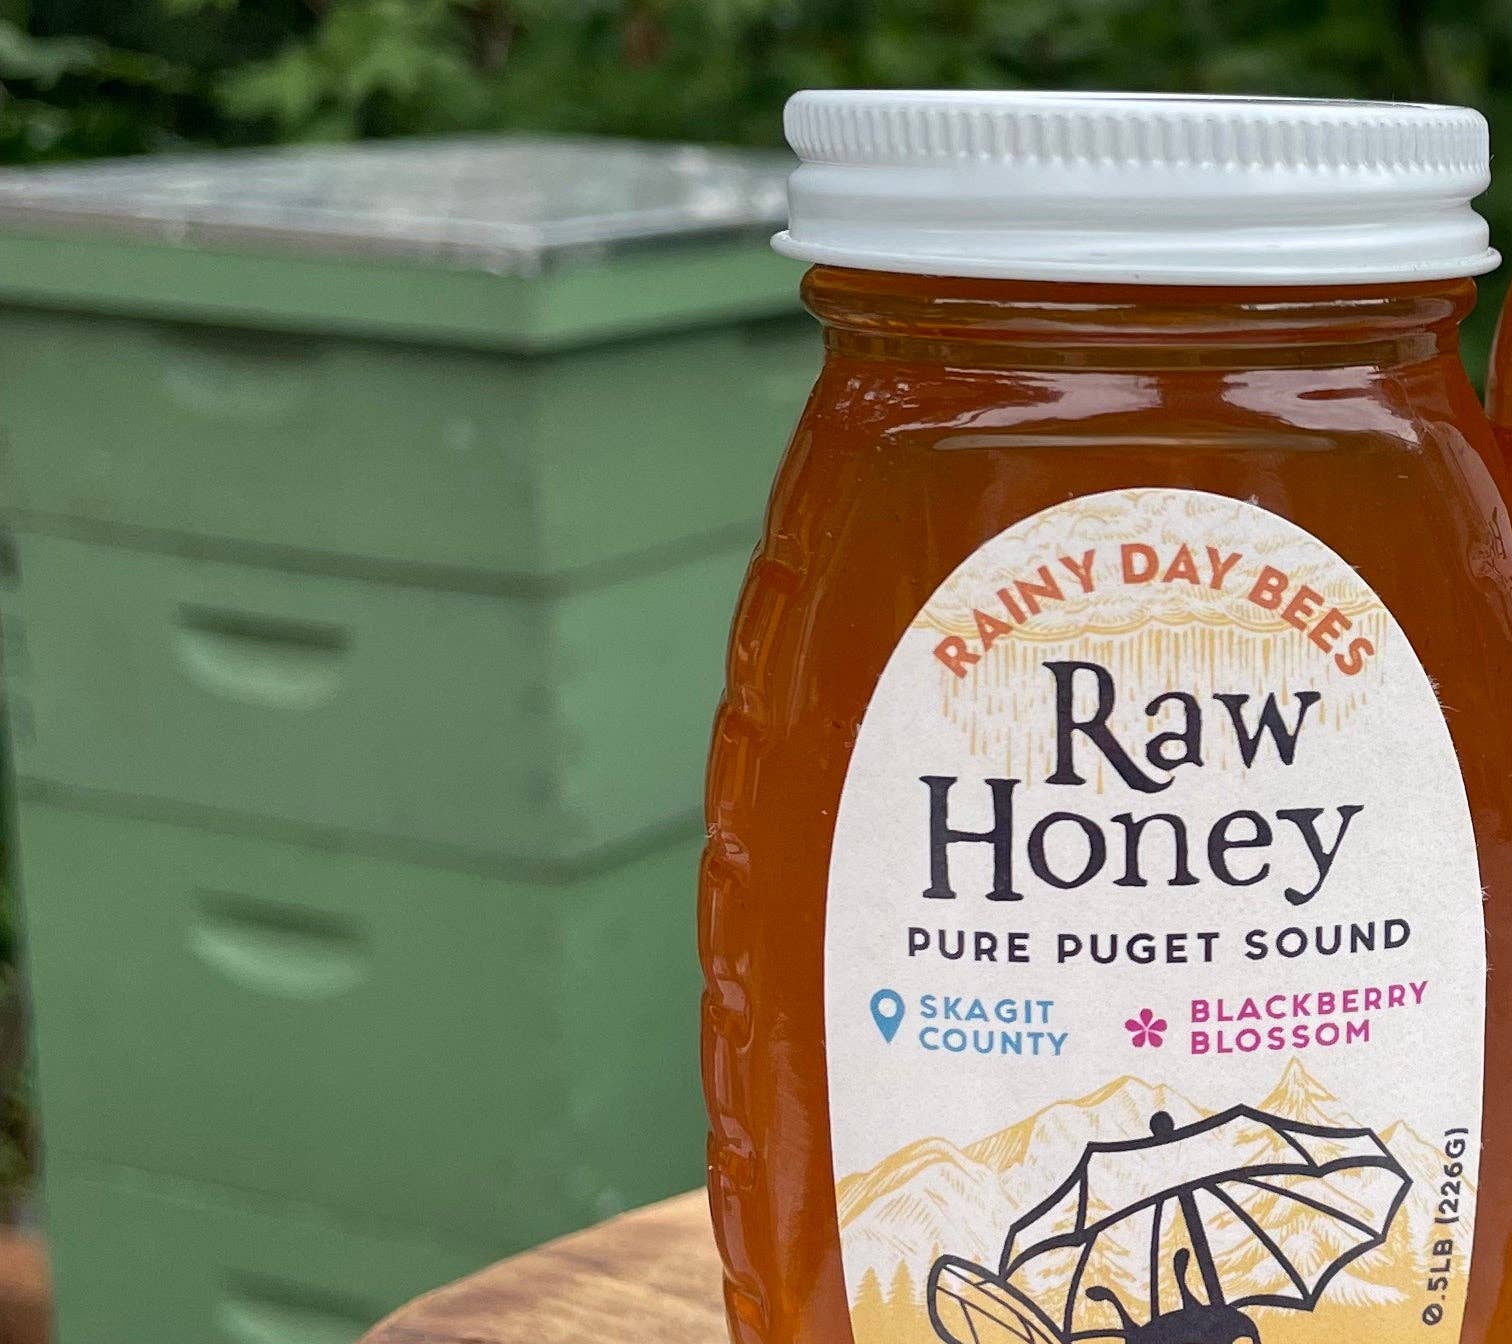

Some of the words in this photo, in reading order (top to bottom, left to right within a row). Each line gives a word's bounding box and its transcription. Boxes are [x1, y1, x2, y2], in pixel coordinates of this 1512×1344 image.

[932, 548, 1098, 679] RAINY
[1120, 542, 1242, 590] DAY
[1248, 563, 1375, 678] BEES
[1042, 660, 1322, 794] Raw
[919, 775, 1365, 907] Honey
[908, 927, 1031, 963] PURE
[1057, 932, 1220, 965] PUGET
[1244, 918, 1412, 962] SOUND
[919, 994, 1055, 1025] SKAGIT
[1190, 981, 1428, 1025] BLACKBERRY
[918, 1026, 1069, 1057] COUNTY
[1190, 1019, 1371, 1056] BLOSSOM
